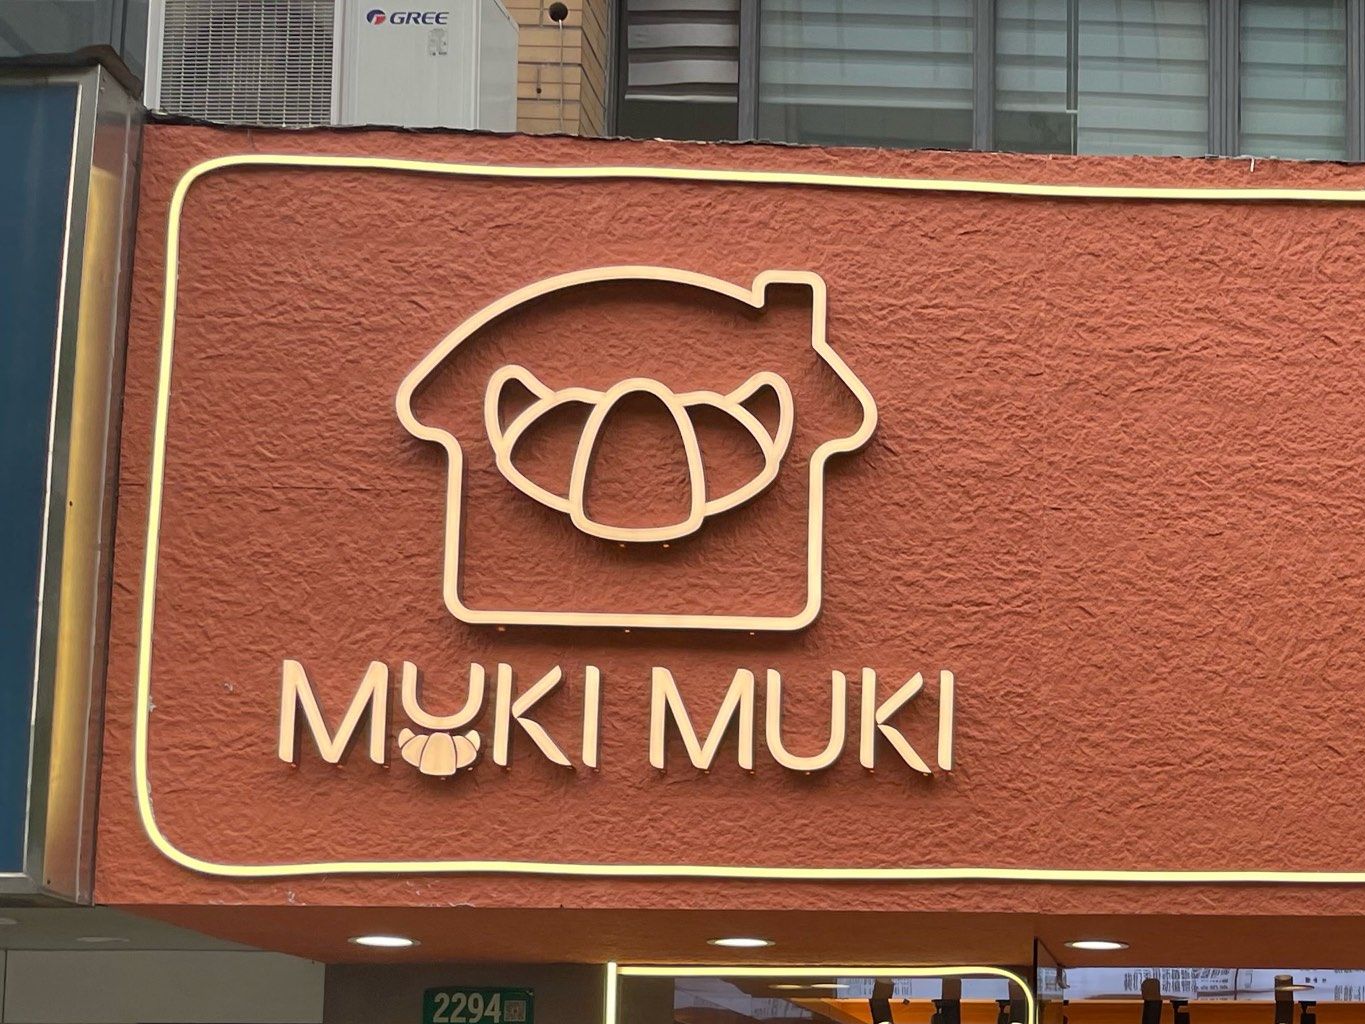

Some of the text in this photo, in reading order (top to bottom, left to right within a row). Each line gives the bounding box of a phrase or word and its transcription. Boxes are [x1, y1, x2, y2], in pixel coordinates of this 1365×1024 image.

[390, 11, 450, 25] GREE
[278, 659, 954, 774] MUKI MUKI
[432, 992, 502, 1023] 2294
